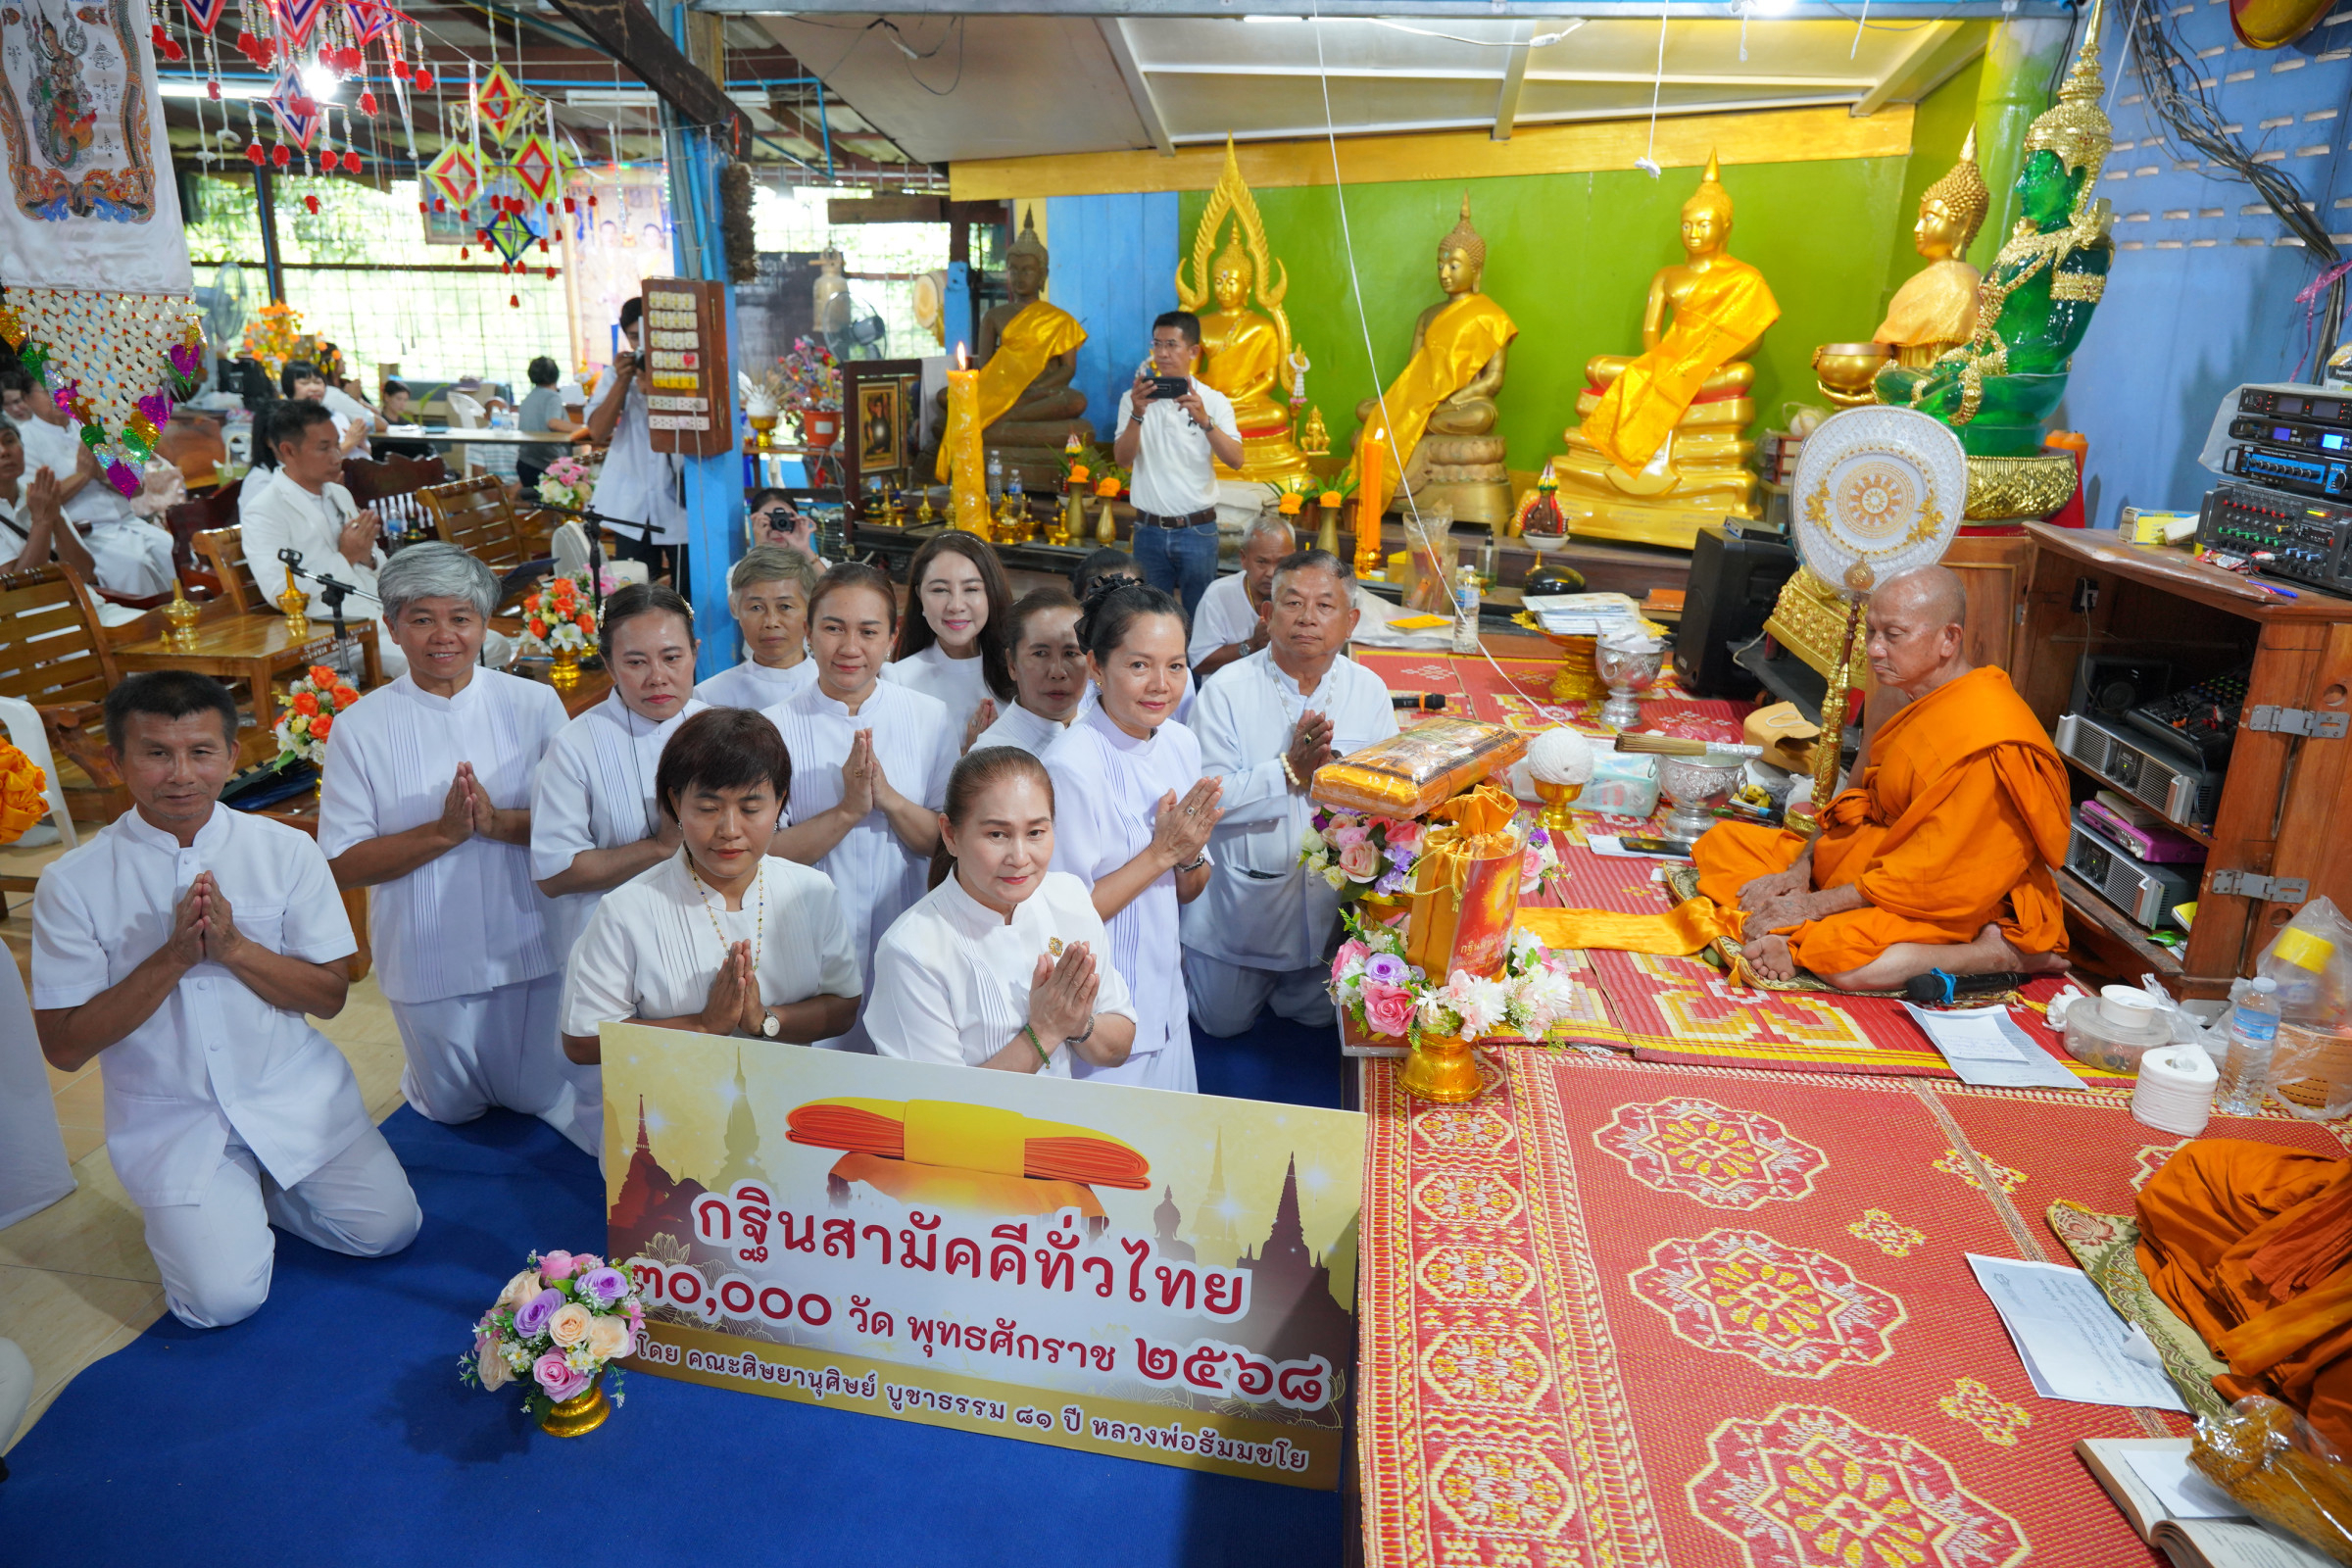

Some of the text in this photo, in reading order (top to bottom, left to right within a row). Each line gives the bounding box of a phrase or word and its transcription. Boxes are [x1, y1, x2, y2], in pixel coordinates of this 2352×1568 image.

[698, 1186, 1244, 1315] กฐินสามัคคีทั่วไทย
[632, 1264, 1324, 1403] ๓๐,๐๐๐ วัด พุทธศักราช ๒๕๖๘
[636, 1333, 1306, 1469] โดย คณะศิษยานุศิษย์ บูชาธรรม ๘๑ ปี หลวงพ่อธัมมชโย
